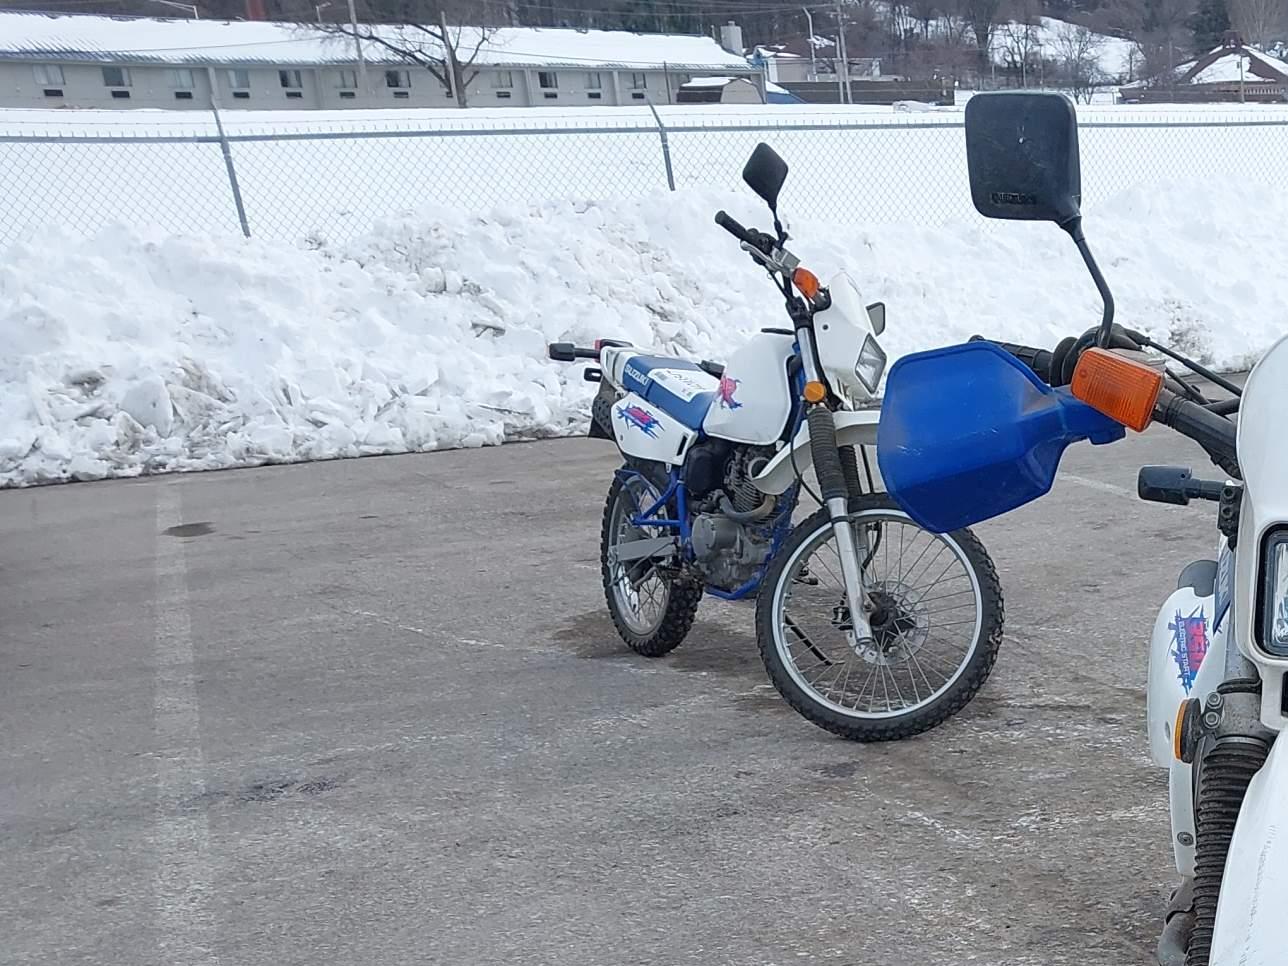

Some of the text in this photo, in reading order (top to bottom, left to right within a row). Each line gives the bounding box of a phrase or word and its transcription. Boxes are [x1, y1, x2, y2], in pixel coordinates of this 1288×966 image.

[624, 363, 650, 386] SUZUKI
[1178, 621, 1191, 676] ELECTRIC START
